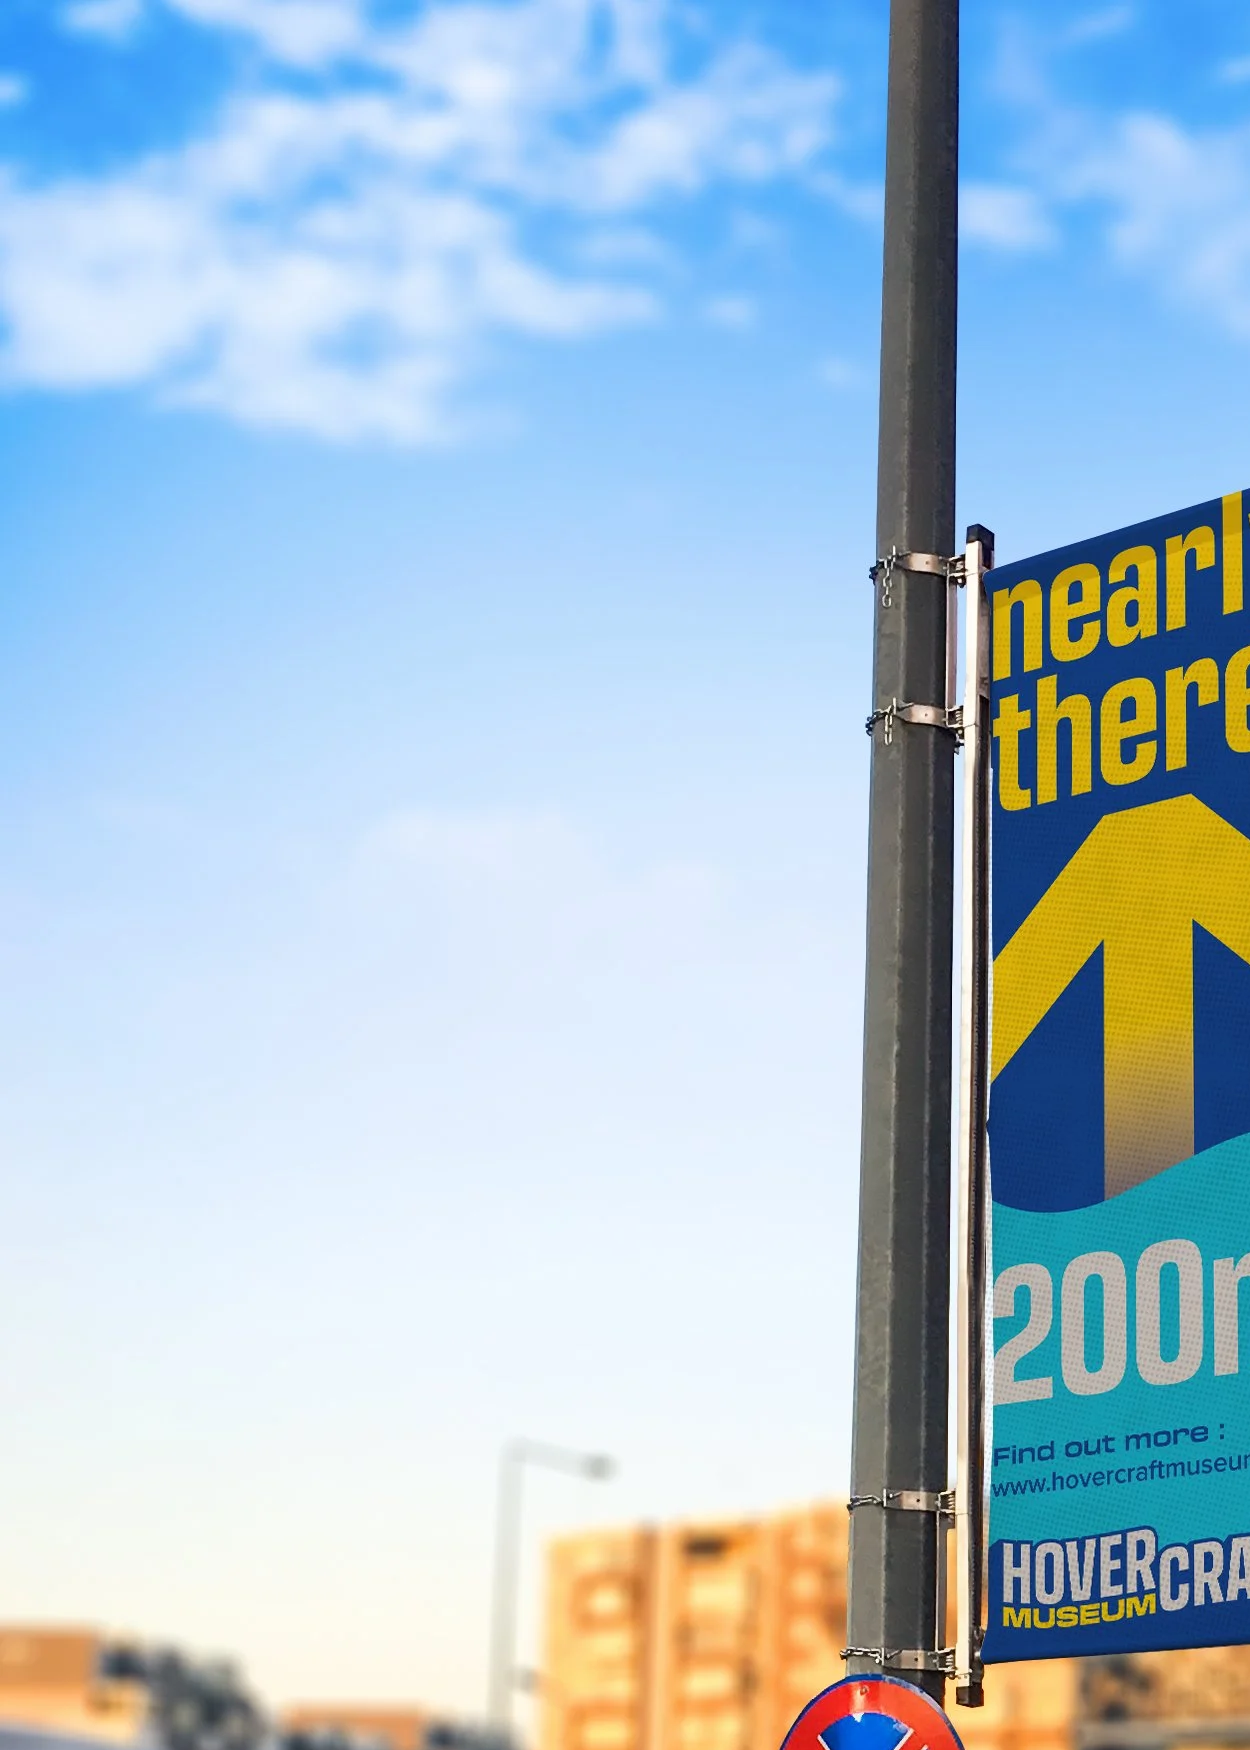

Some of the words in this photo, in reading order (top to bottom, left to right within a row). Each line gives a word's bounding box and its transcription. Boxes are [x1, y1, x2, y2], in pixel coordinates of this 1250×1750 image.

[993, 1440, 1056, 1467] Find
[1064, 1433, 1116, 1459] out
[1125, 1423, 1210, 1451] more
[1002, 1593, 1157, 1629] MUSEUM
